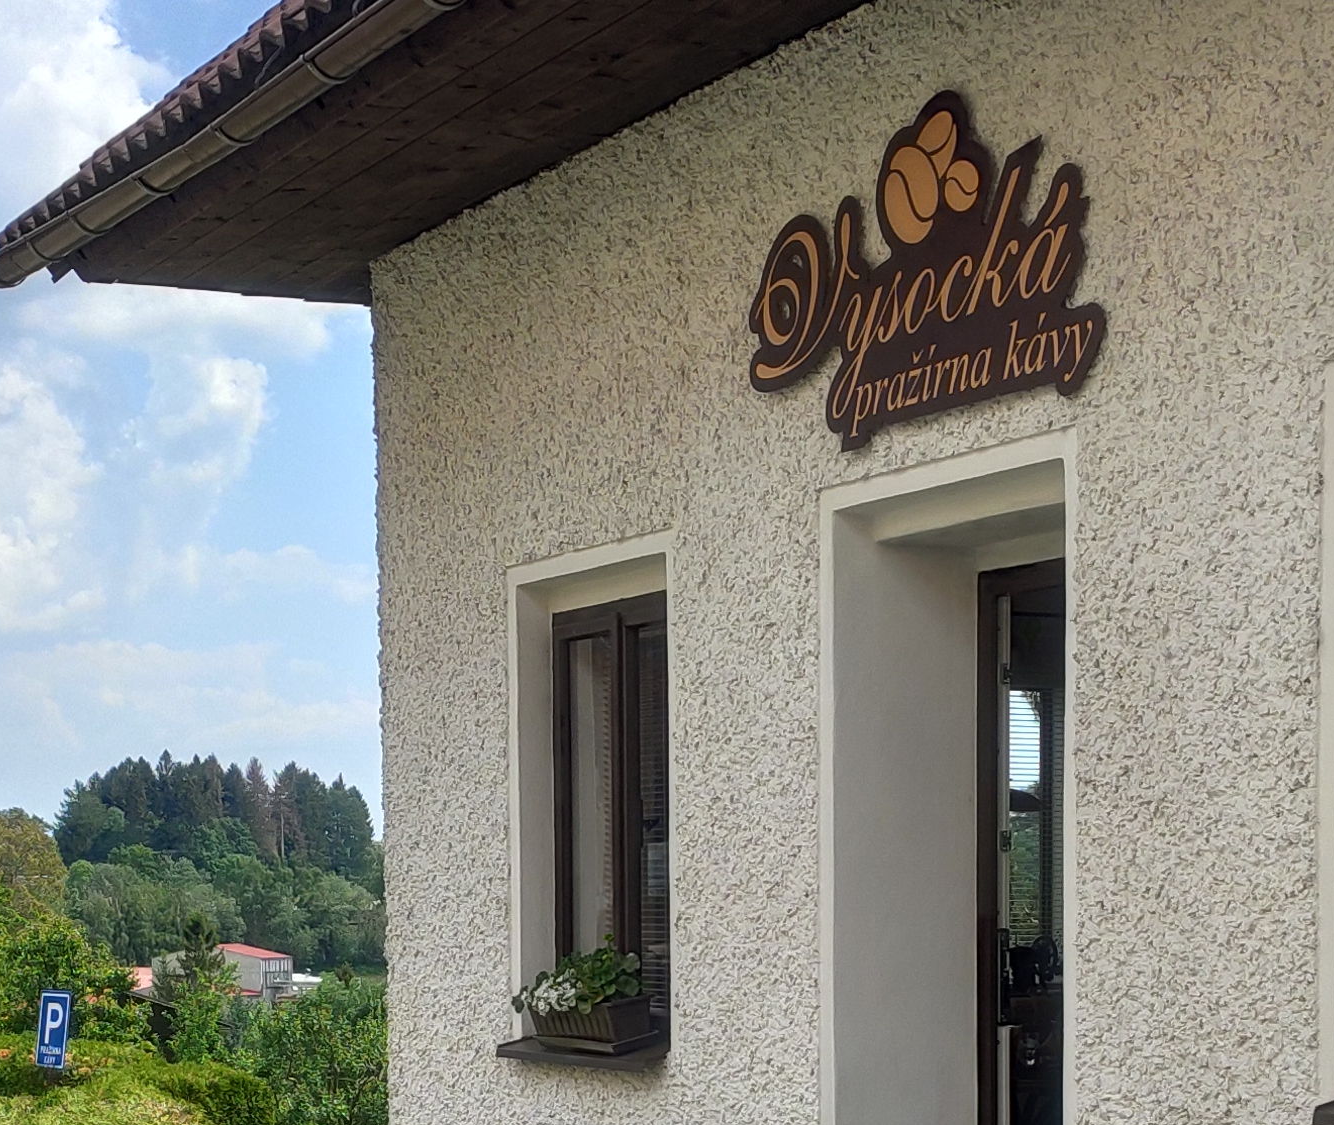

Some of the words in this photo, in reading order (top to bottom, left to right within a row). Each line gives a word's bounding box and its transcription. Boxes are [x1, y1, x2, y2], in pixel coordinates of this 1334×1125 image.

[755, 166, 1072, 419] Vysocká
[850, 343, 993, 438] pražírna
[1002, 311, 1093, 382] kávy
[44, 1002, 64, 1044] P
